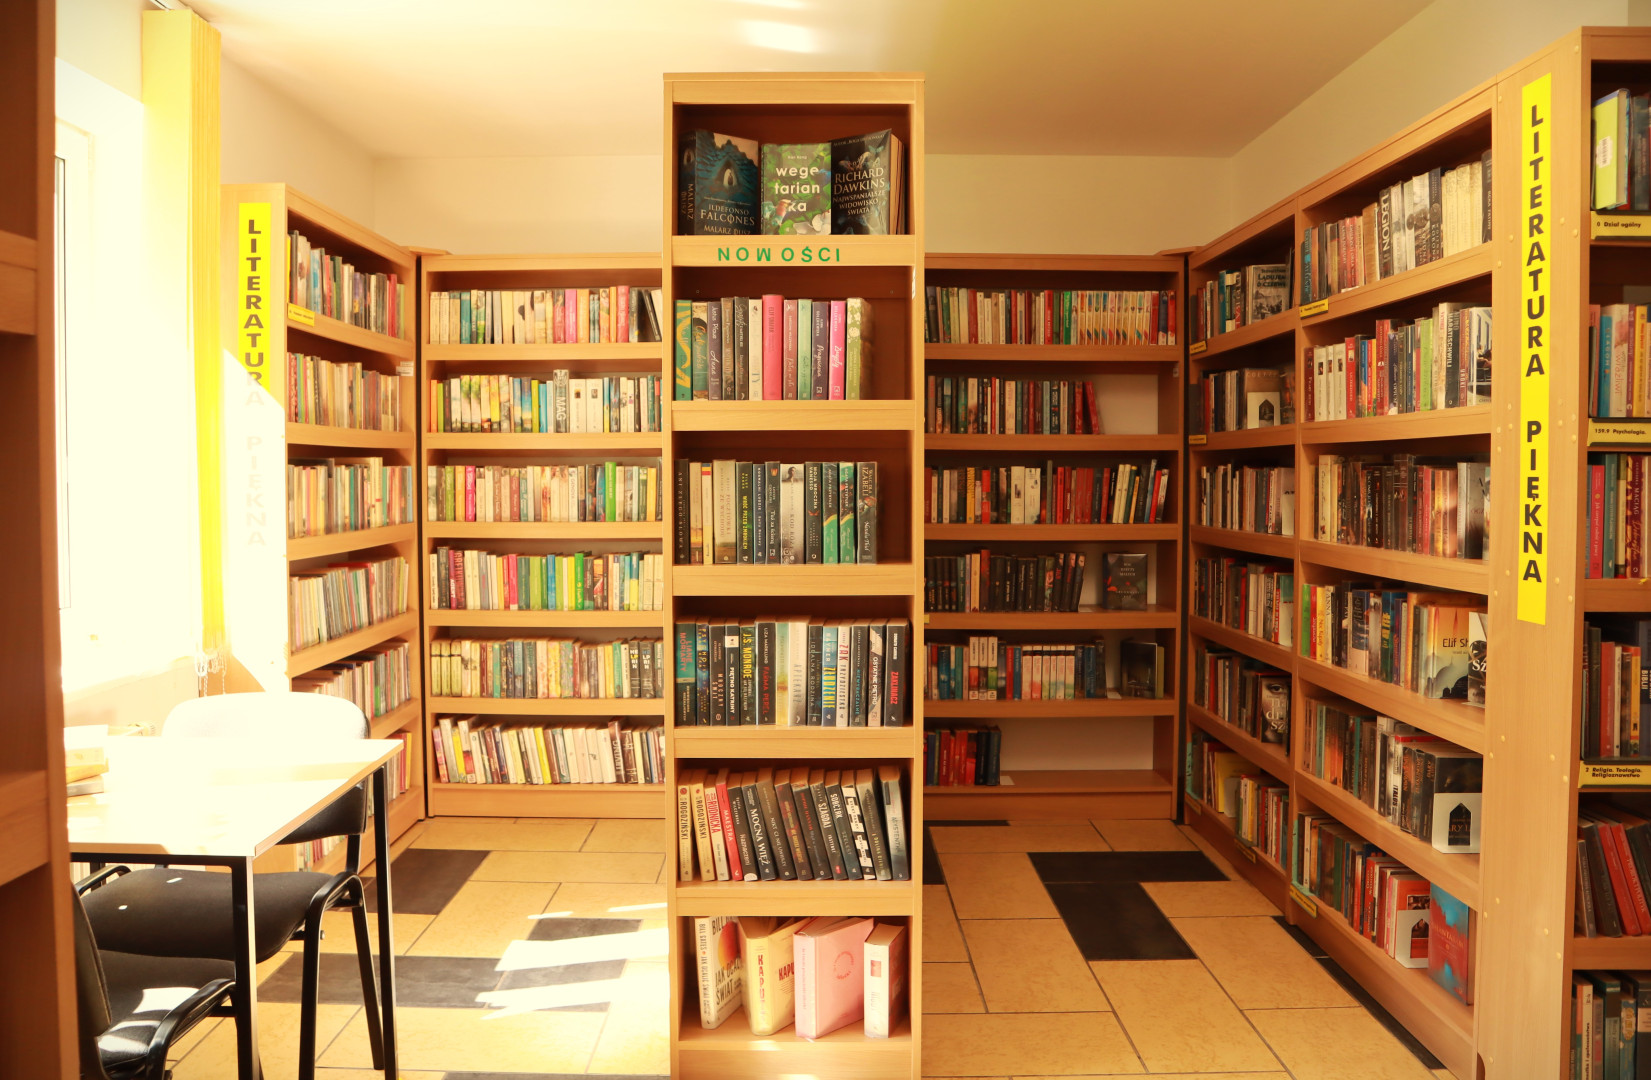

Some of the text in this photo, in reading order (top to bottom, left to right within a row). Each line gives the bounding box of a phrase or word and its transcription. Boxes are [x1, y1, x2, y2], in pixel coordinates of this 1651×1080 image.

[776, 166, 819, 179] wege
[775, 182, 820, 194] tarian
[717, 246, 840, 263] NOWOŚCI
[1523, 105, 1544, 584] LITERATURA PIĘKNA
[743, 648, 752, 678] MONROE
[724, 809, 733, 842] MAESTRA
[750, 808, 763, 842] MOCNA
